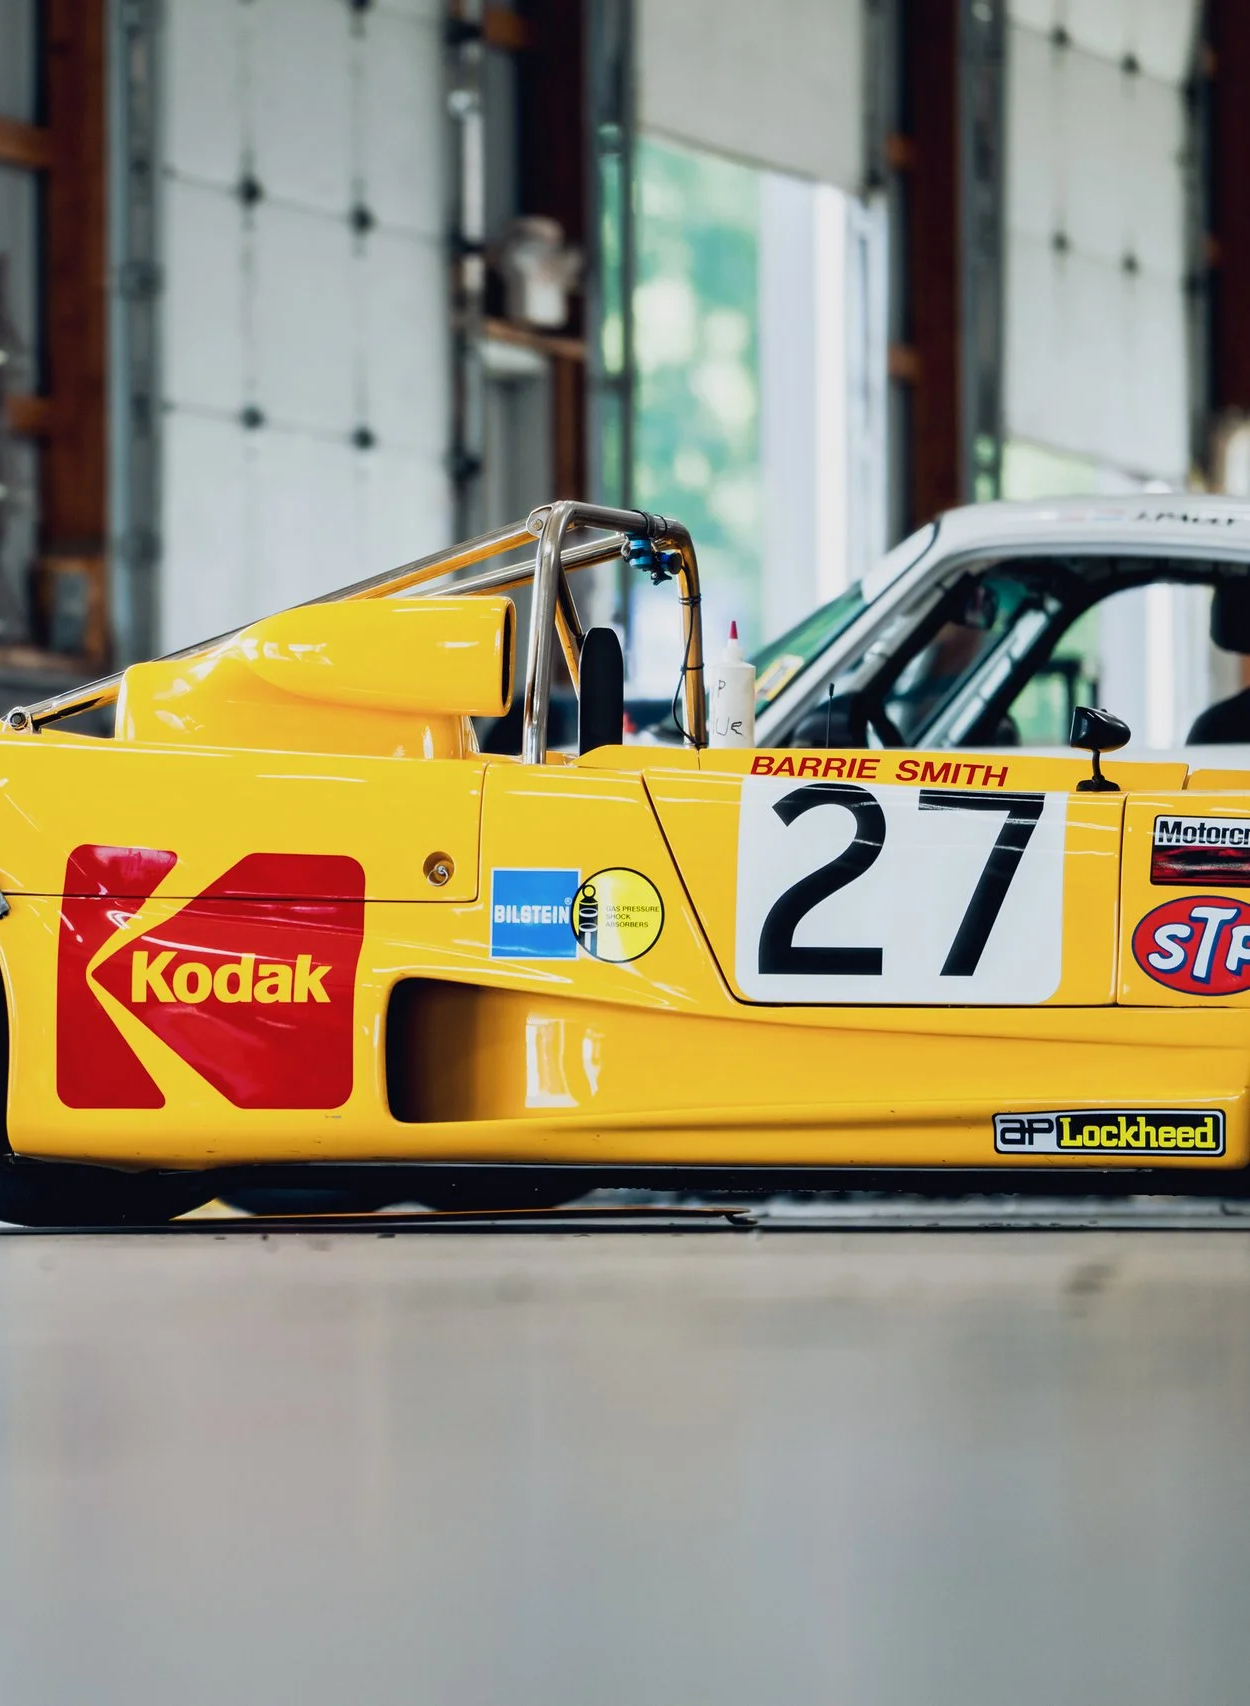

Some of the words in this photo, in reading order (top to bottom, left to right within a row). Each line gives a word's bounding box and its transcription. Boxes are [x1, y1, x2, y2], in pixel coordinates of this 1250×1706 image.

[750, 756, 881, 779] BARRIE
[895, 759, 1009, 787] SMITH
[758, 782, 1046, 977] 27
[494, 904, 571, 925] BILSTEIN
[131, 950, 333, 1004] Kodak
[1059, 1116, 1216, 1149] Lockheed
